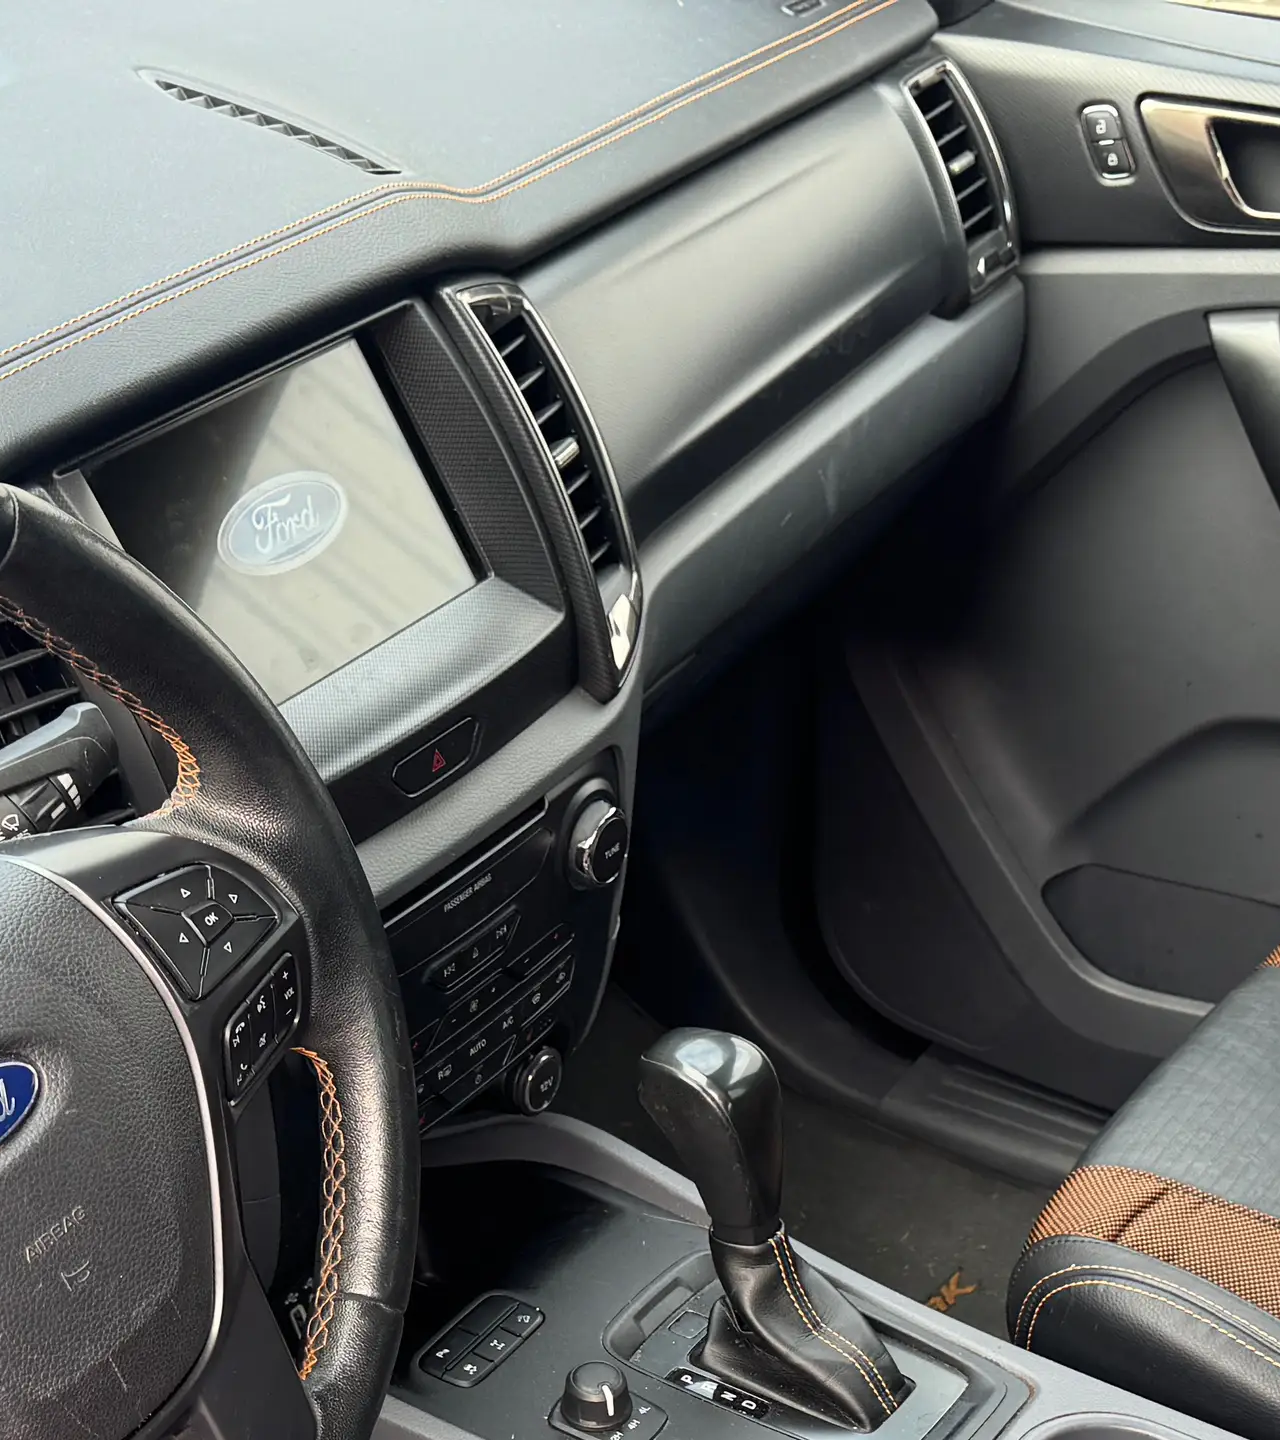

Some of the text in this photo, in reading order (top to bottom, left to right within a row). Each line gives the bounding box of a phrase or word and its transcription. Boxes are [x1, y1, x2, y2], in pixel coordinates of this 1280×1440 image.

[252, 493, 319, 554] Ford
[204, 912, 219, 926] OK
[470, 1039, 487, 1056] AUTO
[539, 1076, 553, 1092] 12V
[26, 1205, 86, 1264] AIRBAG
[681, 1374, 693, 1384] P
[721, 1391, 737, 1401] N
[741, 1400, 757, 1410] D
[638, 1406, 651, 1415] 4L
[628, 1419, 641, 1430] 4H
